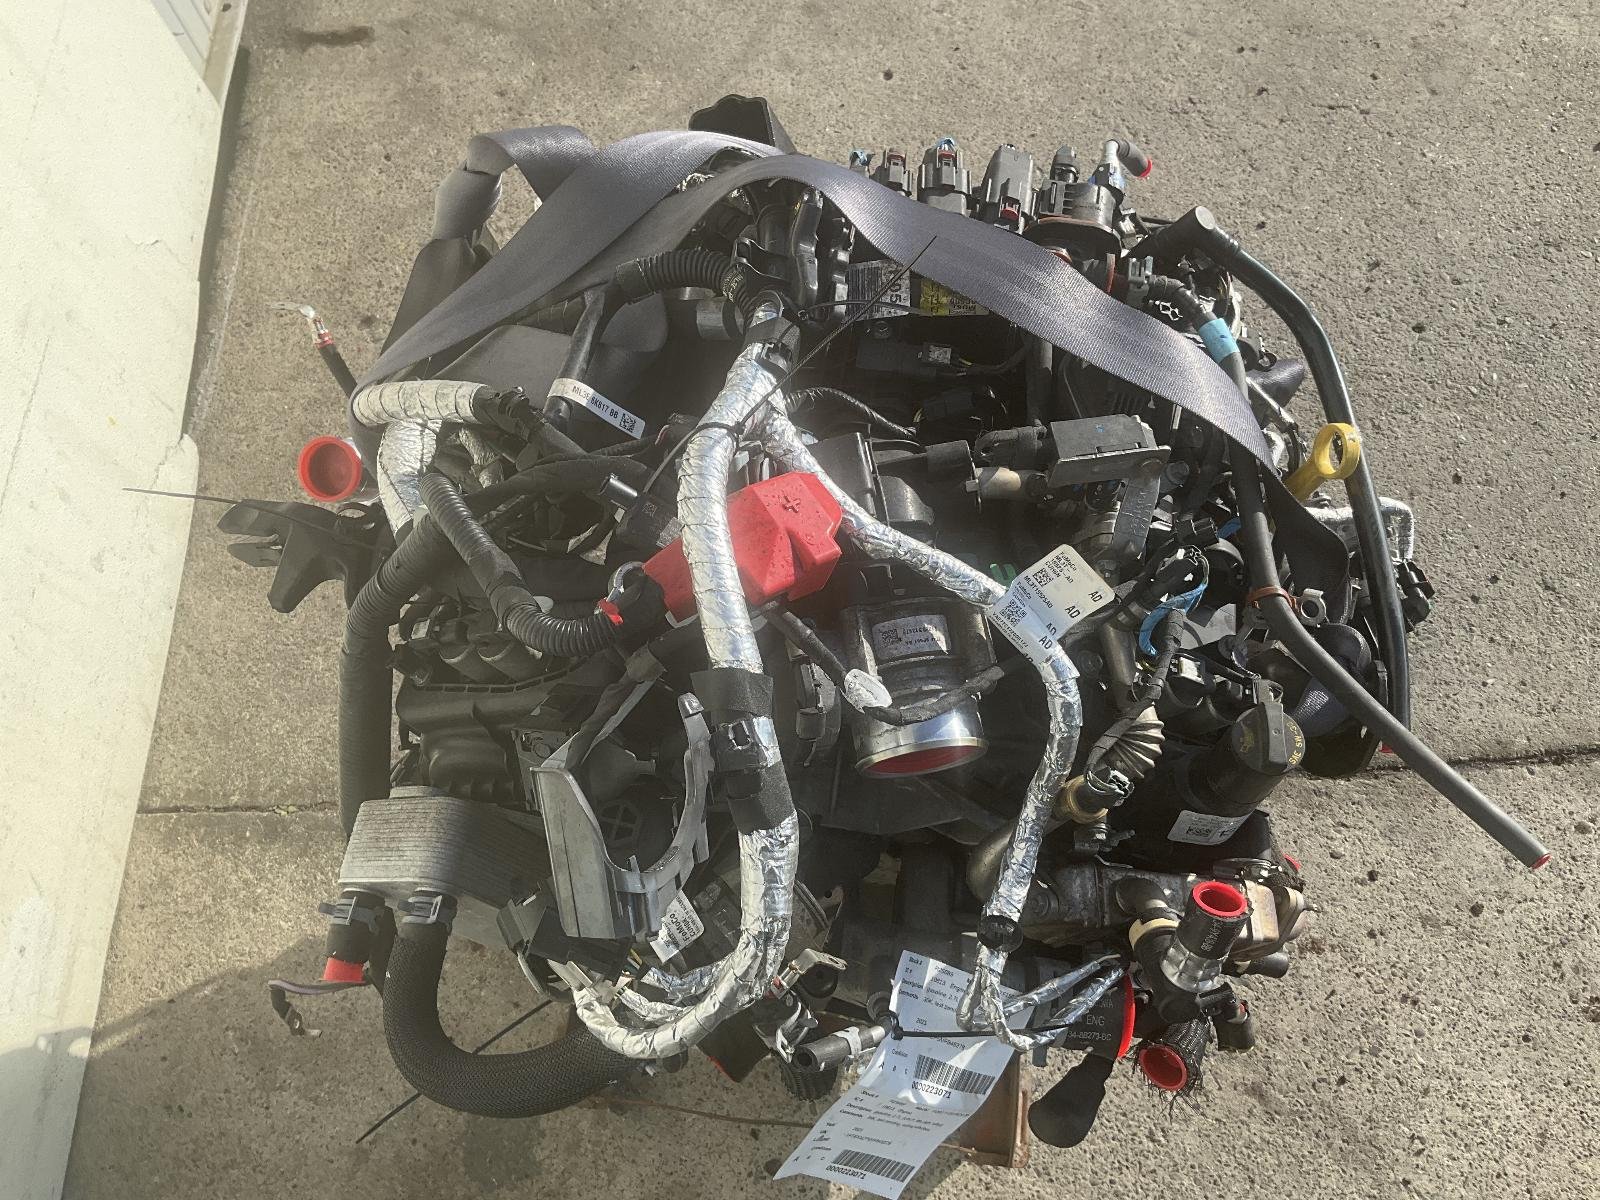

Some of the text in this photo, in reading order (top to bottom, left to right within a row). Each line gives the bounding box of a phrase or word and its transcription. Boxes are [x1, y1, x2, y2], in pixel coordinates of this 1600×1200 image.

[572, 385, 591, 401] ML3E
[1088, 591, 1103, 603] AD
[1065, 605, 1081, 619] AD
[1038, 635, 1053, 650] AD
[1288, 749, 1302, 765] SAE
[669, 913, 690, 942] FoMoCo
[1086, 1014, 1105, 1026] ENG
[825, 1165, 867, 1179] 0000223071
